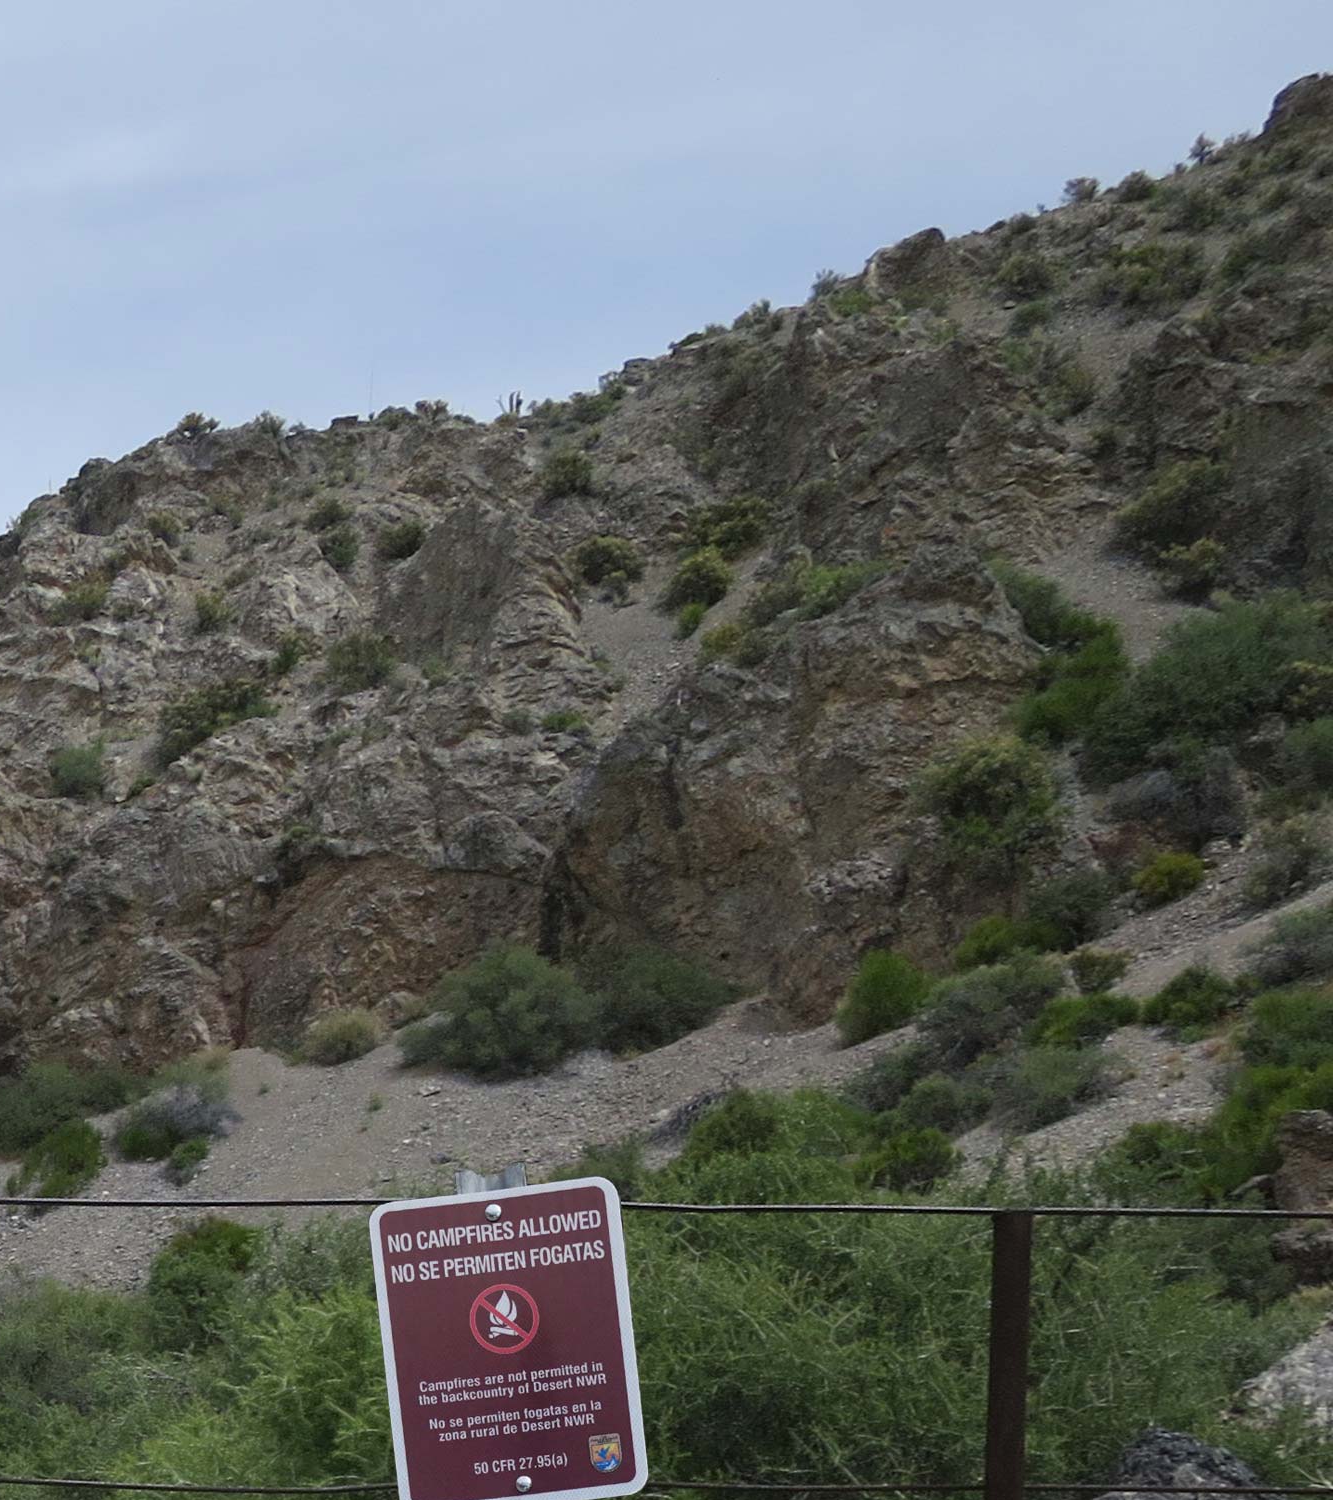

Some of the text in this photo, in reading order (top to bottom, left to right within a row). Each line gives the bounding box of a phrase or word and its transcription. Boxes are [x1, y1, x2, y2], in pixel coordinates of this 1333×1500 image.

[387, 1209, 602, 1254] NO CAMPFIRES ALLOWED
[390, 1239, 605, 1284] NO SE PERMITEN FOGATAS
[418, 1373, 607, 1406] the backcountry of Desert NWR
[419, 1361, 603, 1393] Campfires are not permitted in
[429, 1399, 602, 1430] No se permiten fogatas en la
[438, 1413, 595, 1442] zona rural de Desert NWR
[473, 1452, 568, 1475] 50 CFR 27.95(a)
